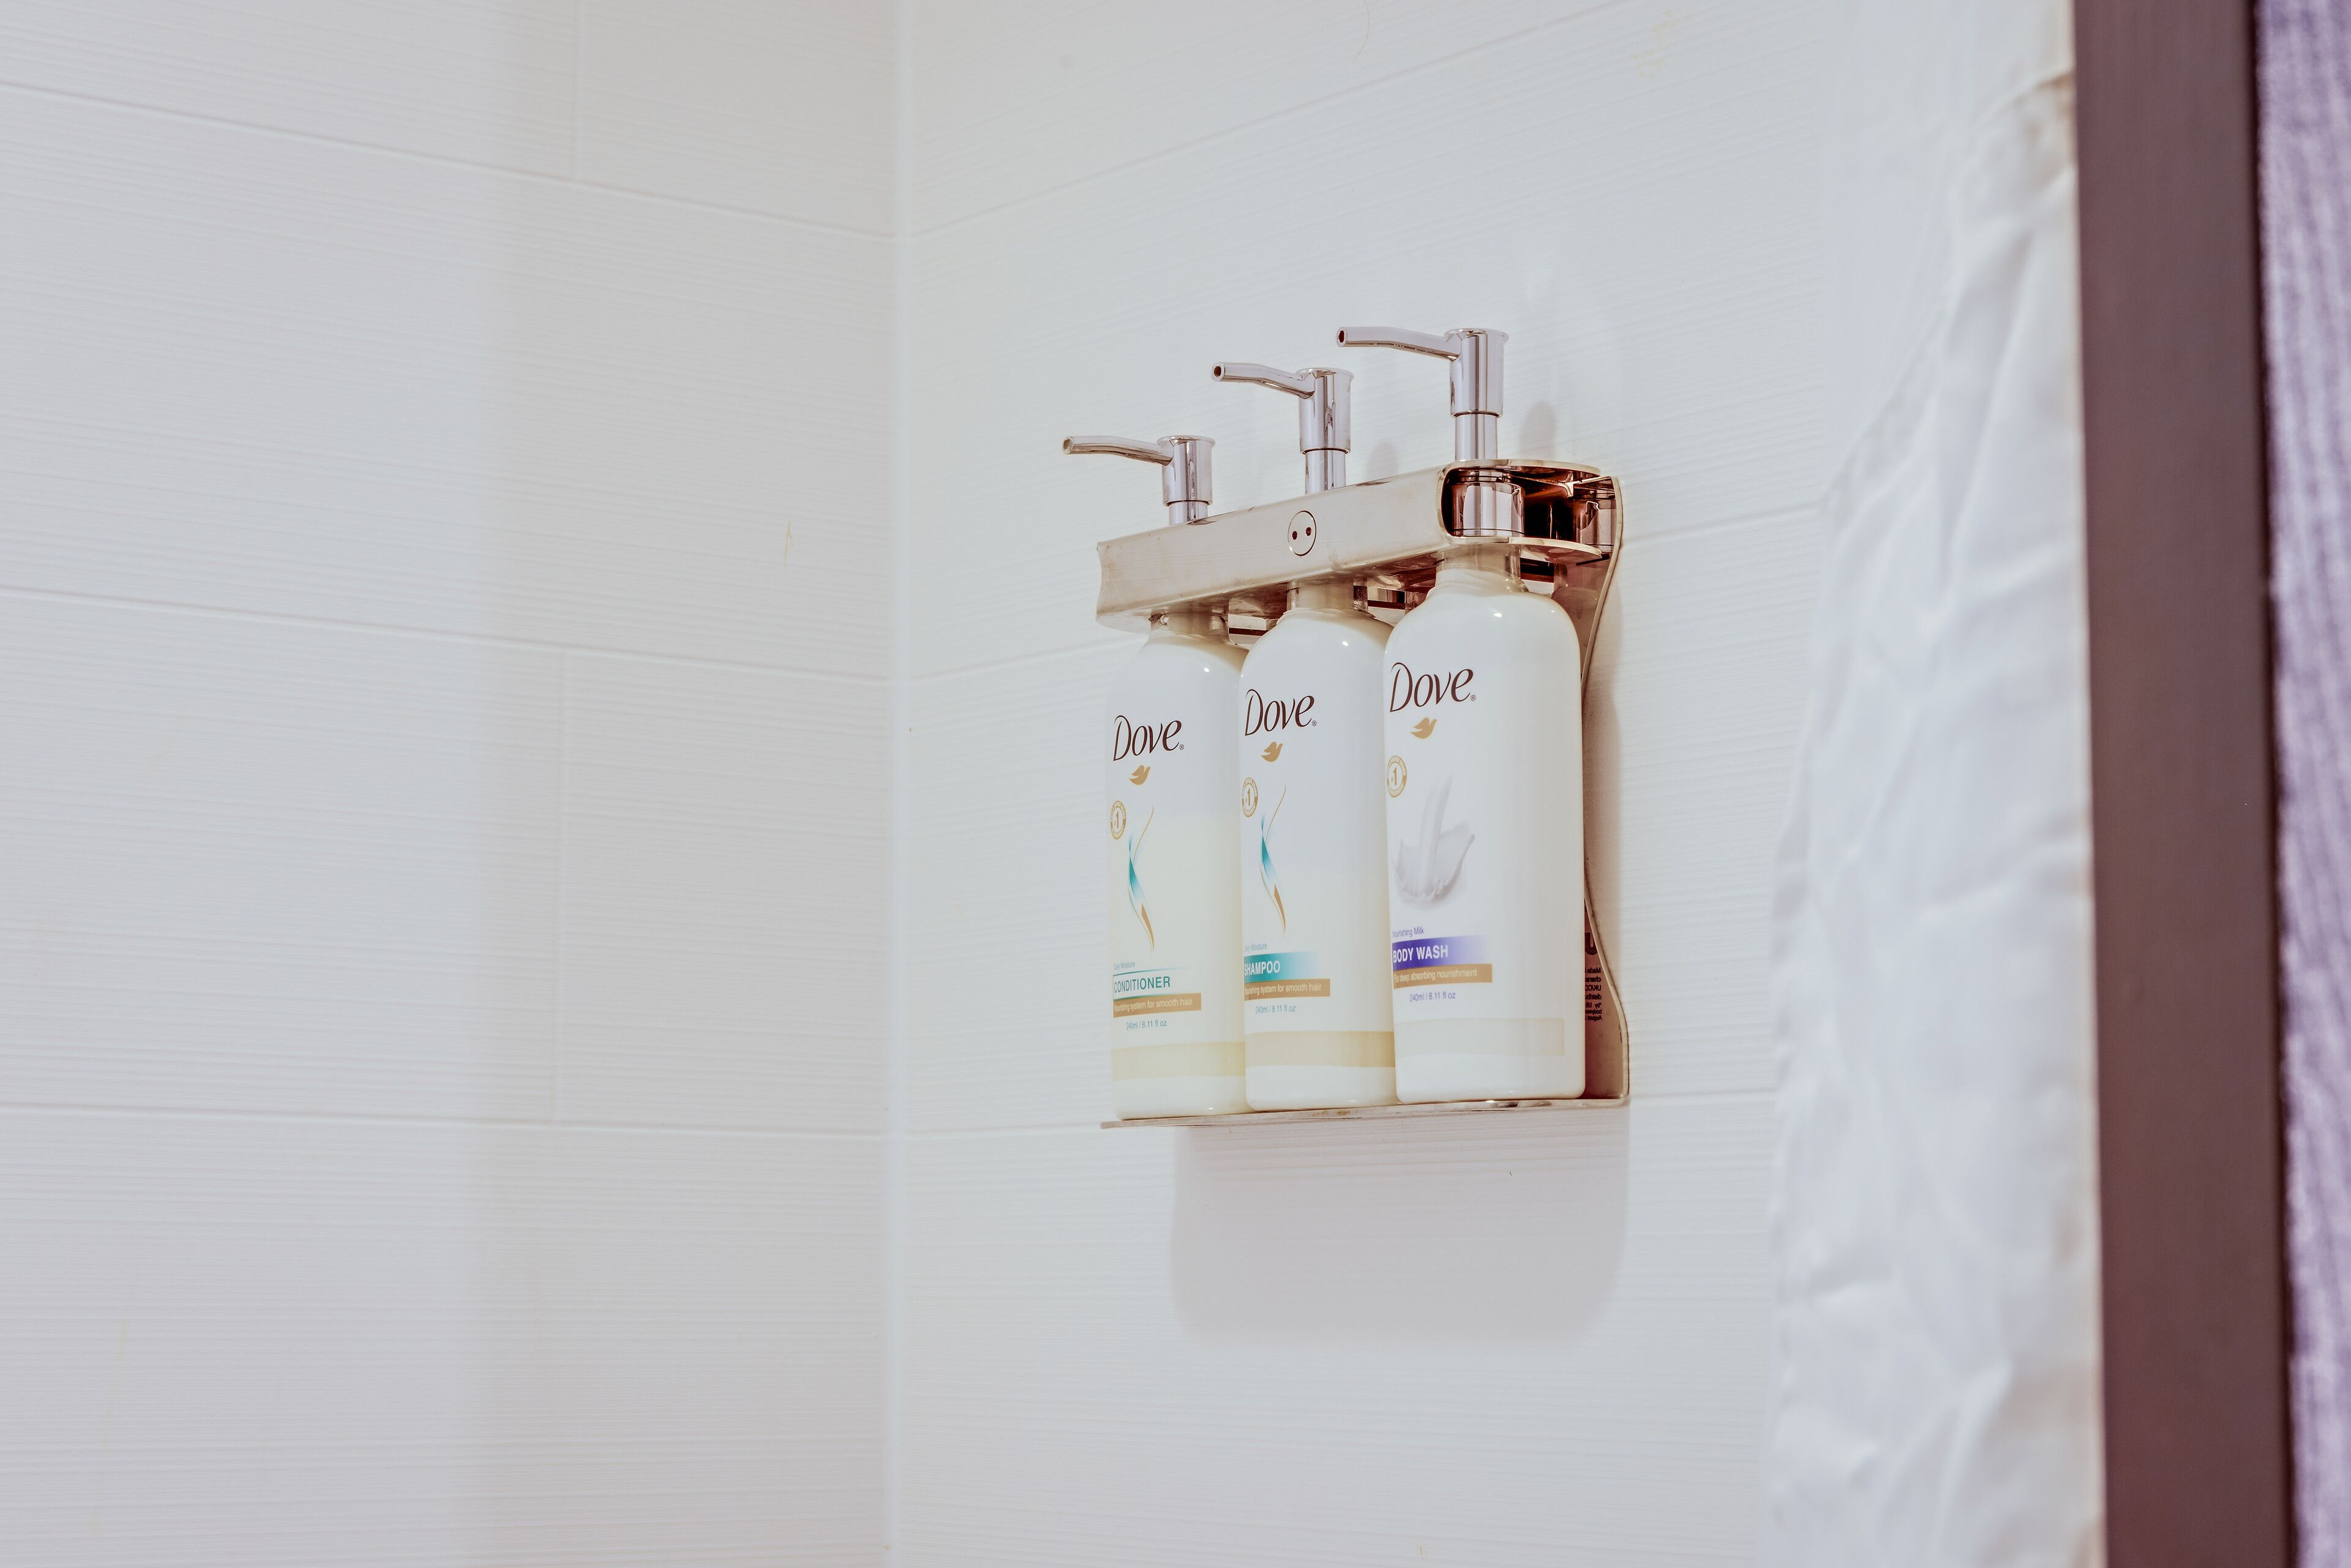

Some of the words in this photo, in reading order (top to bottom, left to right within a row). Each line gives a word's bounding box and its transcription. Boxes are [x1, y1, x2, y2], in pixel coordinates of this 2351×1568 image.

[1390, 662, 1474, 712] Dove
[1245, 689, 1315, 736] Dove
[1113, 715, 1182, 761] Dove
[1393, 948, 1414, 963] BODY
[1416, 945, 1448, 960] WASH
[1244, 960, 1281, 976] SHAMPOO
[1400, 973, 1409, 983] deep
[1411, 971, 1435, 981] absorbing
[1437, 969, 1477, 978] nourishment
[1114, 976, 1171, 994] CONDITIONER
[1260, 985, 1277, 996] system
[1286, 983, 1307, 992] smooth
[1309, 983, 1322, 991] hair
[1130, 1002, 1146, 1011] system
[1156, 999, 1179, 1008] smooth
[1180, 997, 1193, 1006] hair
[1409, 993, 1424, 1002] 240ml
[1429, 992, 1440, 1000] 8.11
[1255, 1005, 1268, 1014] 240ml
[1272, 1004, 1282, 1013] 8.11
[1126, 1021, 1138, 1030] 240ml
